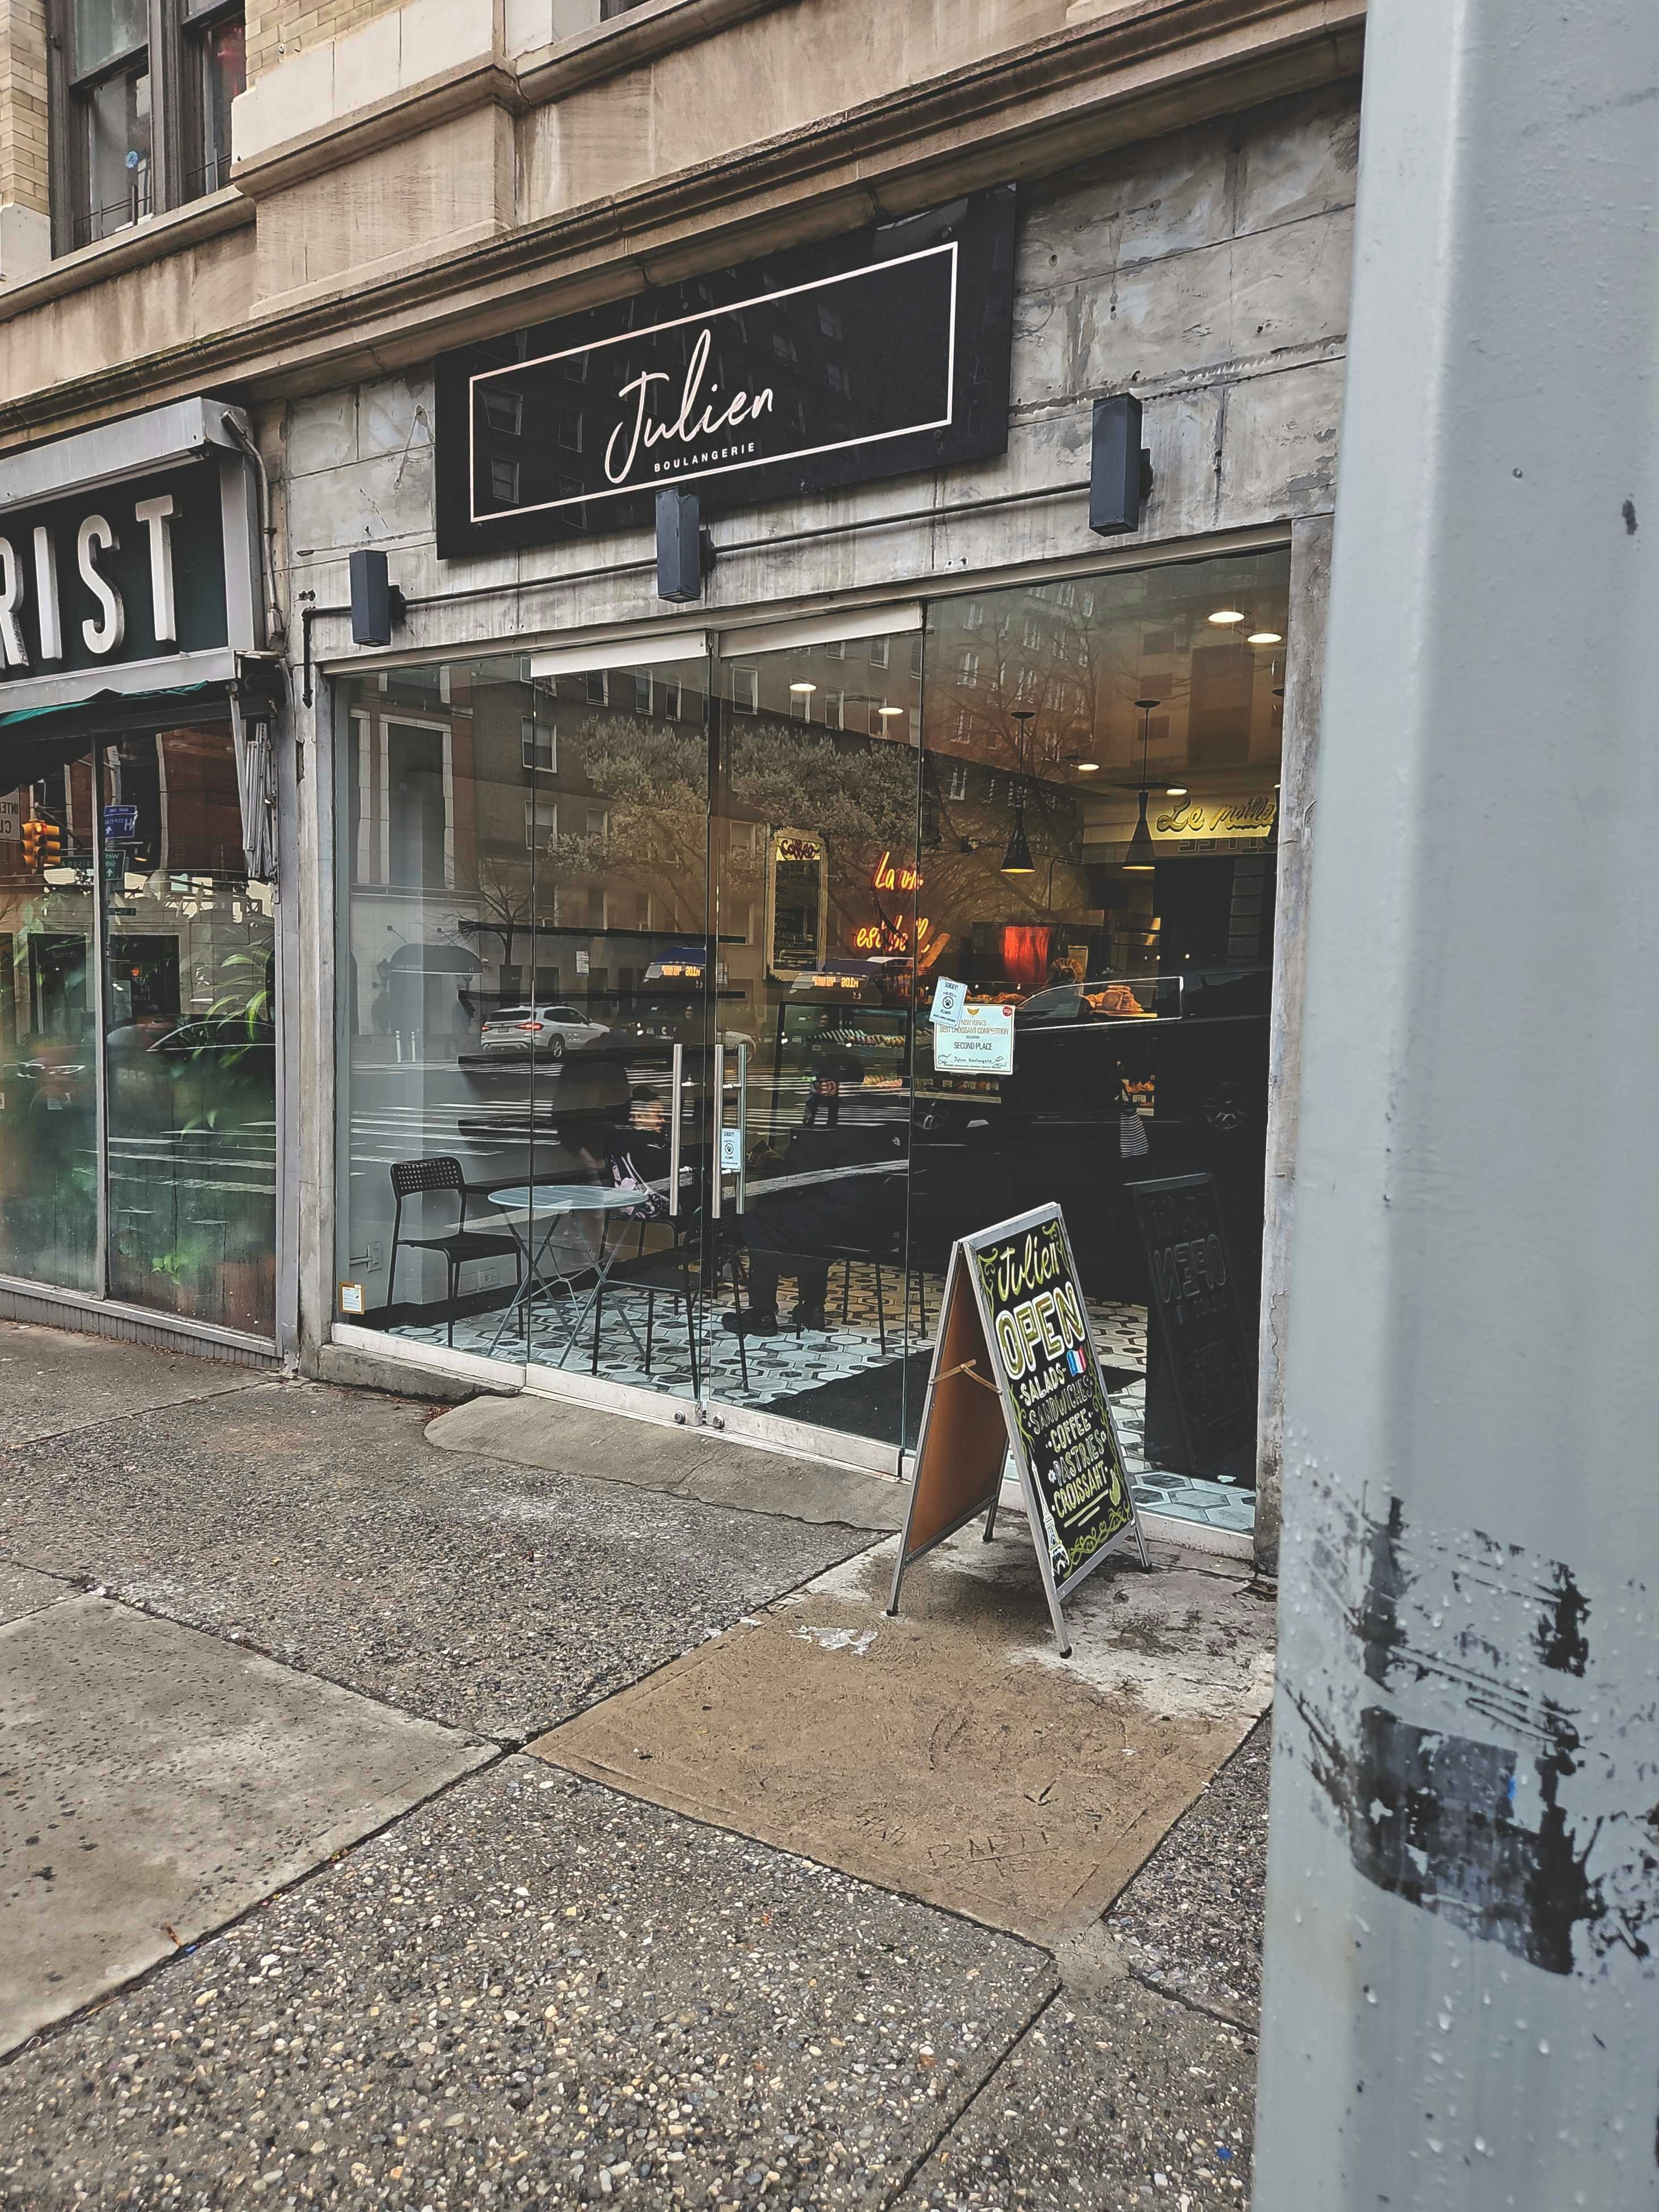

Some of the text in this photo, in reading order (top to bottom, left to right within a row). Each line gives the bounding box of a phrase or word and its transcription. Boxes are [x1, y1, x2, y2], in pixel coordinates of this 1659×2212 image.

[604, 328, 773, 484] Julien
[654, 442, 755, 472] BOULANGERIE
[874, 851, 895, 891] La
[975, 1042, 993, 1051] PLACE
[998, 1233, 1060, 1302] Julien
[995, 1280, 1085, 1380] OPEN
[1020, 1362, 1065, 1407] SALADS
[1029, 1374, 1093, 1435] SANDWICHES
[1050, 1408, 1091, 1453] COFFEE
[1052, 1428, 1105, 1487] PASTRIES
[1053, 1460, 1107, 1519] CROISSANT
